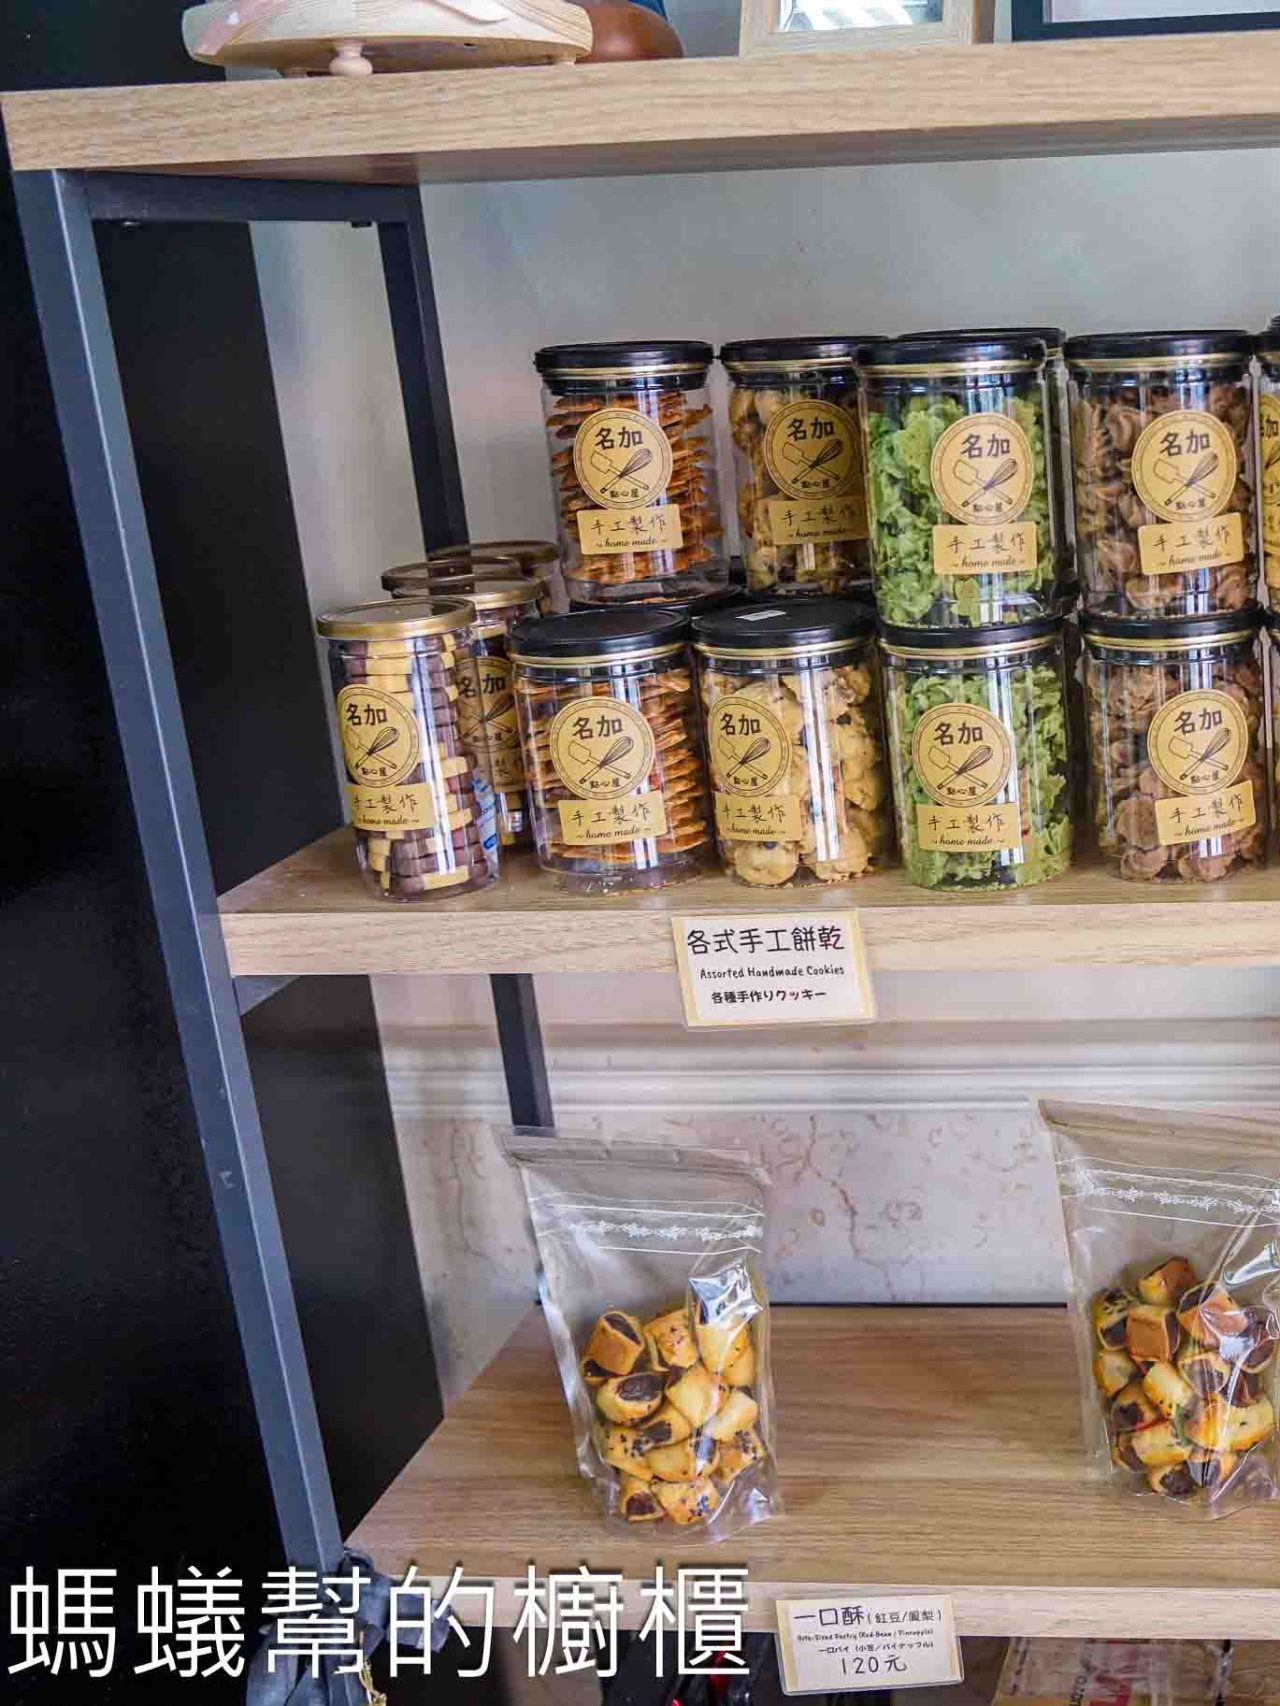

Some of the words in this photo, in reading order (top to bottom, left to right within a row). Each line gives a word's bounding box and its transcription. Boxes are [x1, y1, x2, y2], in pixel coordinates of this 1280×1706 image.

[787, 416, 834, 441] 名加
[1260, 413, 1279, 437] 加
[595, 427, 643, 450] 名加
[961, 434, 1010, 459] 名加
[1160, 429, 1210, 456] 名加
[346, 703, 388, 726] 名加
[720, 712, 761, 736] 名加
[1174, 708, 1223, 735] 名加
[572, 715, 623, 740] 名加
[934, 721, 983, 746] 名加
[688, 925, 845, 955] 各式手工餅乾
[700, 967, 745, 979] Assorted
[748, 965, 804, 978] Handmade
[806, 964, 844, 976] Cookies
[711, 988, 827, 1005] 各種手作りクッキー
